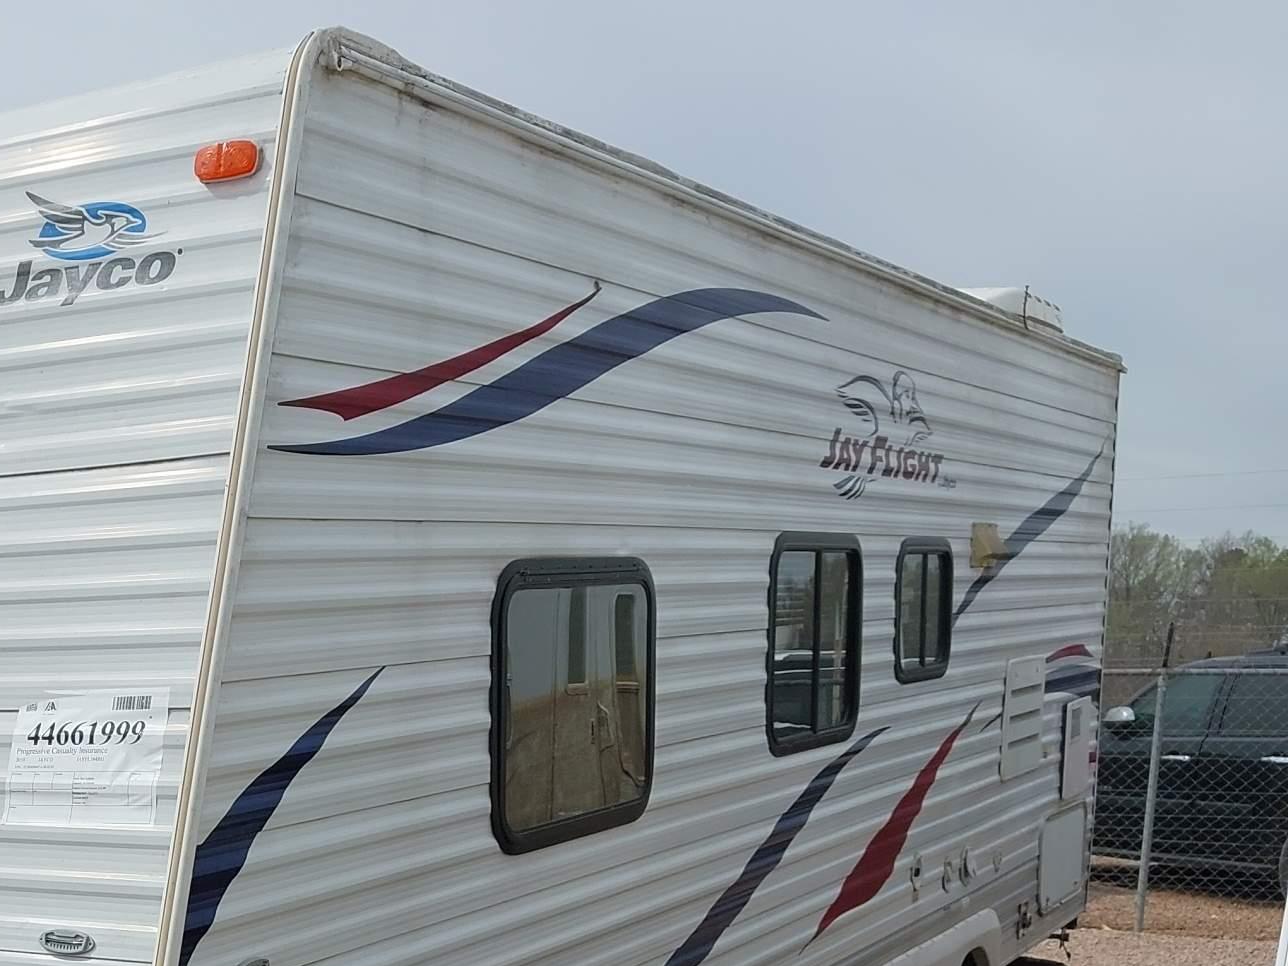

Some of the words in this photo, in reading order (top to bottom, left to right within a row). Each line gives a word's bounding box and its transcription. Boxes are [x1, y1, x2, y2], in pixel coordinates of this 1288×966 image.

[819, 427, 870, 472] JAY
[867, 435, 945, 483] FLIGHT
[27, 720, 146, 745] 44661999
[52, 747, 78, 757] Casualty
[78, 747, 108, 755] Insurance
